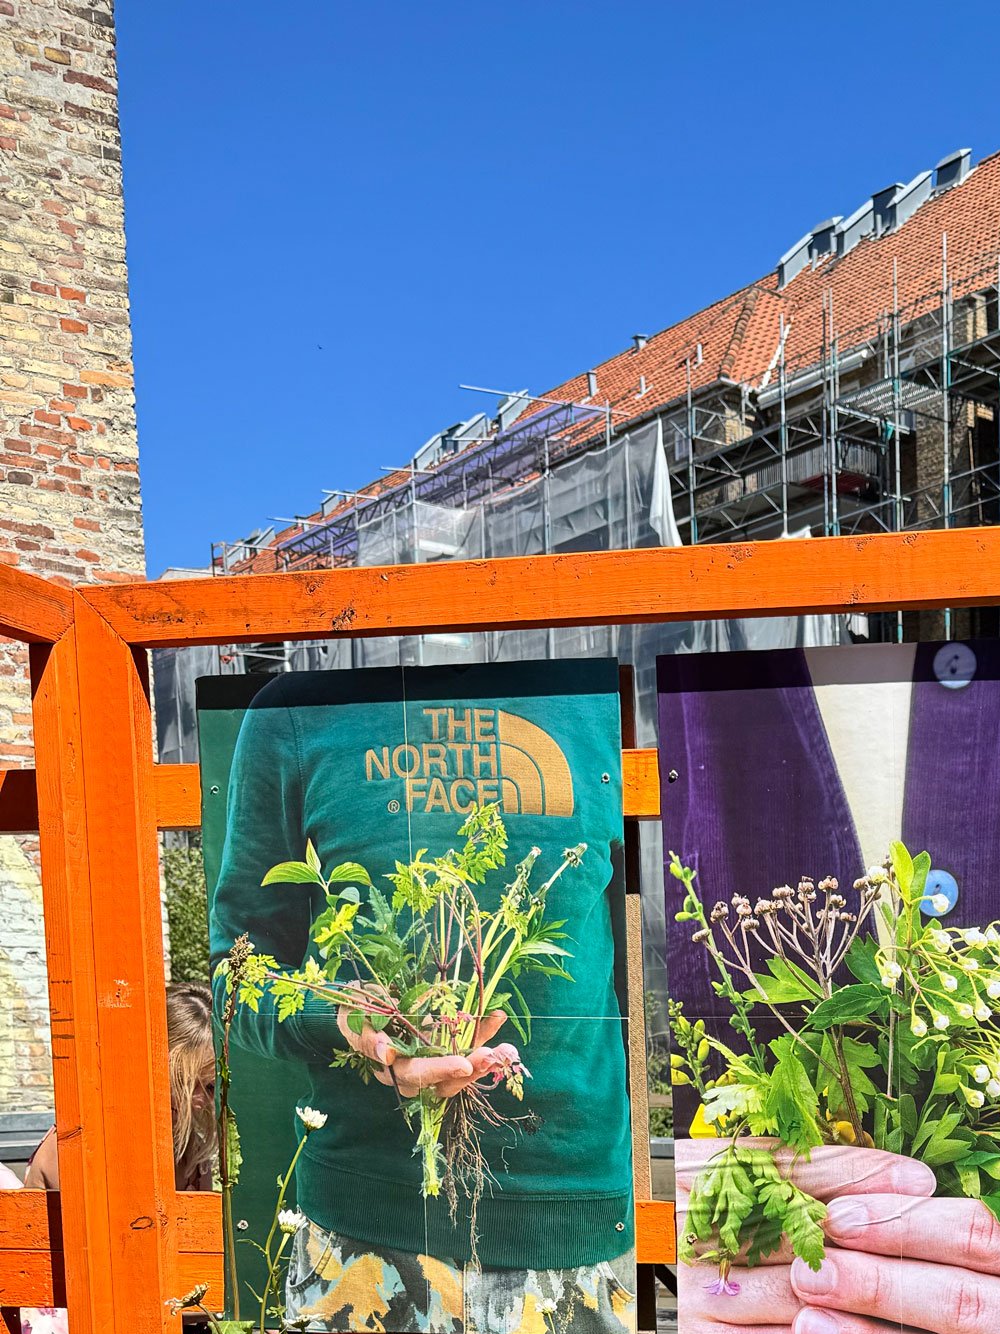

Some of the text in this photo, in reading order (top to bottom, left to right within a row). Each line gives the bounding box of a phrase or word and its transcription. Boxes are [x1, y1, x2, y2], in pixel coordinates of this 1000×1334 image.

[423, 708, 496, 742] THE
[365, 742, 498, 781] NORTH
[406, 777, 499, 814] FACE
